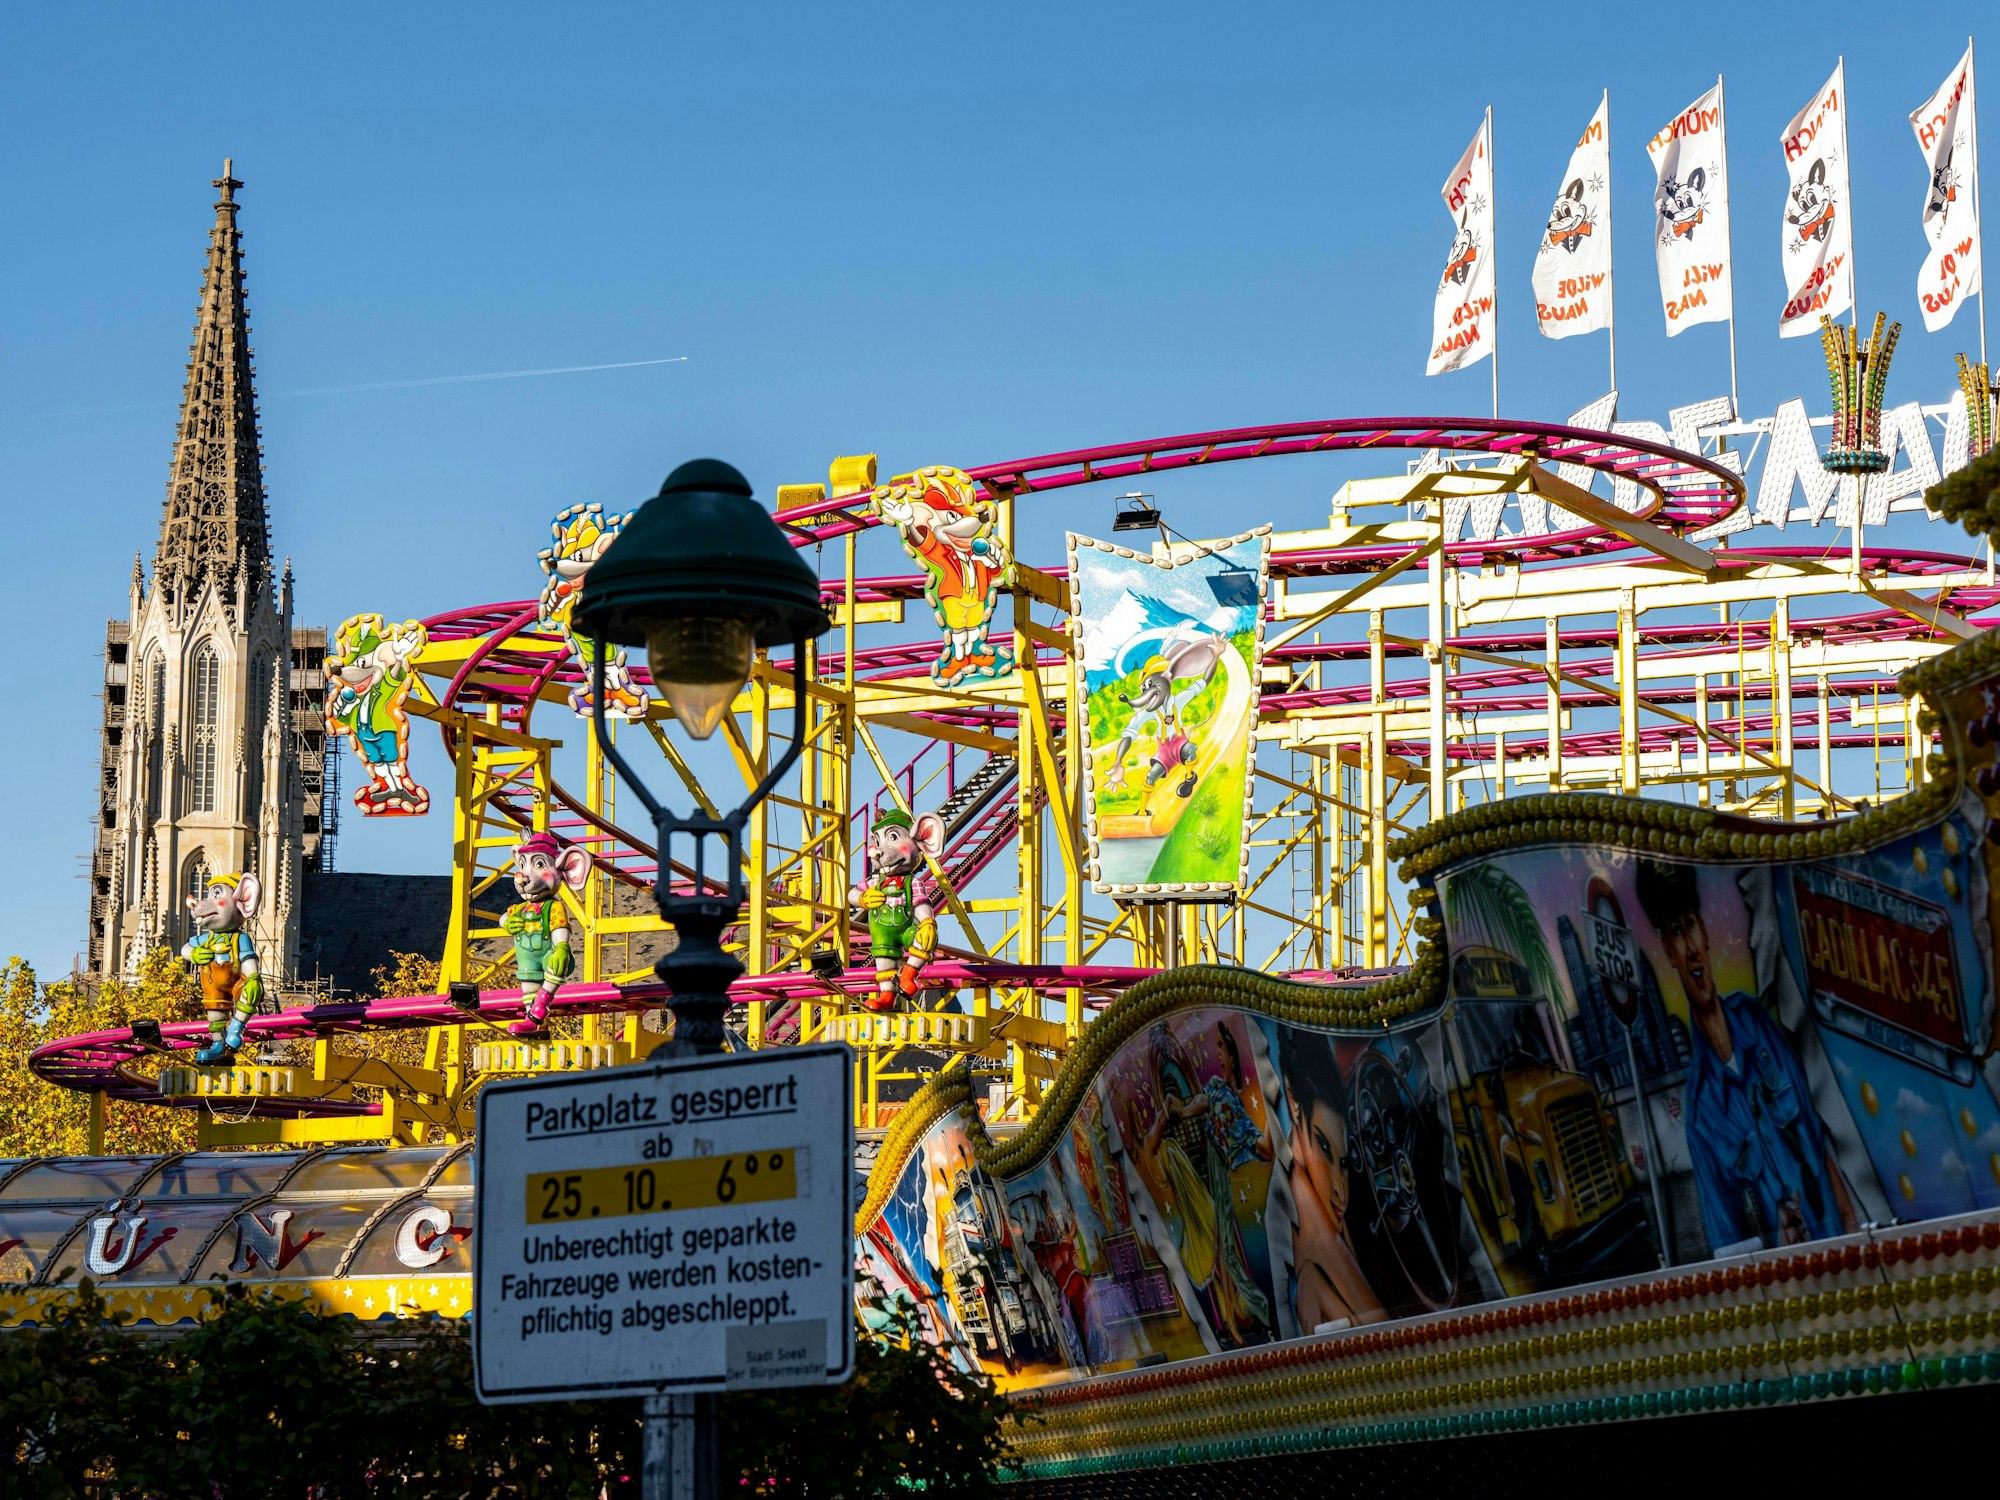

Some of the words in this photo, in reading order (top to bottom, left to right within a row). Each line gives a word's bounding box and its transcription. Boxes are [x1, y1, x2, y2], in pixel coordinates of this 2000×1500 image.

[1594, 919, 1626, 954] BUS
[1800, 908, 1911, 1005] CADILLAC
[1595, 946, 1634, 986] STOP
[525, 1094, 657, 1135] Parkplatz
[670, 1074, 797, 1125] gesperrt
[641, 1131, 673, 1161] ab
[541, 1174, 601, 1220] 25.
[623, 1167, 673, 1214] 10.
[523, 1226, 673, 1265] Unberechtigt
[682, 1215, 797, 1255] geparkte
[501, 1269, 620, 1302] Fahrzeuge
[628, 1259, 717, 1290] werden
[727, 1251, 823, 1284] kosten-
[521, 1303, 613, 1342] pflichtig
[620, 1289, 798, 1332] abgeschleppt.
[726, 1367, 746, 1381] Der
[749, 1362, 826, 1382] Bürgermeister
[745, 1349, 774, 1363] Stadt
[777, 1347, 808, 1361] Soest
